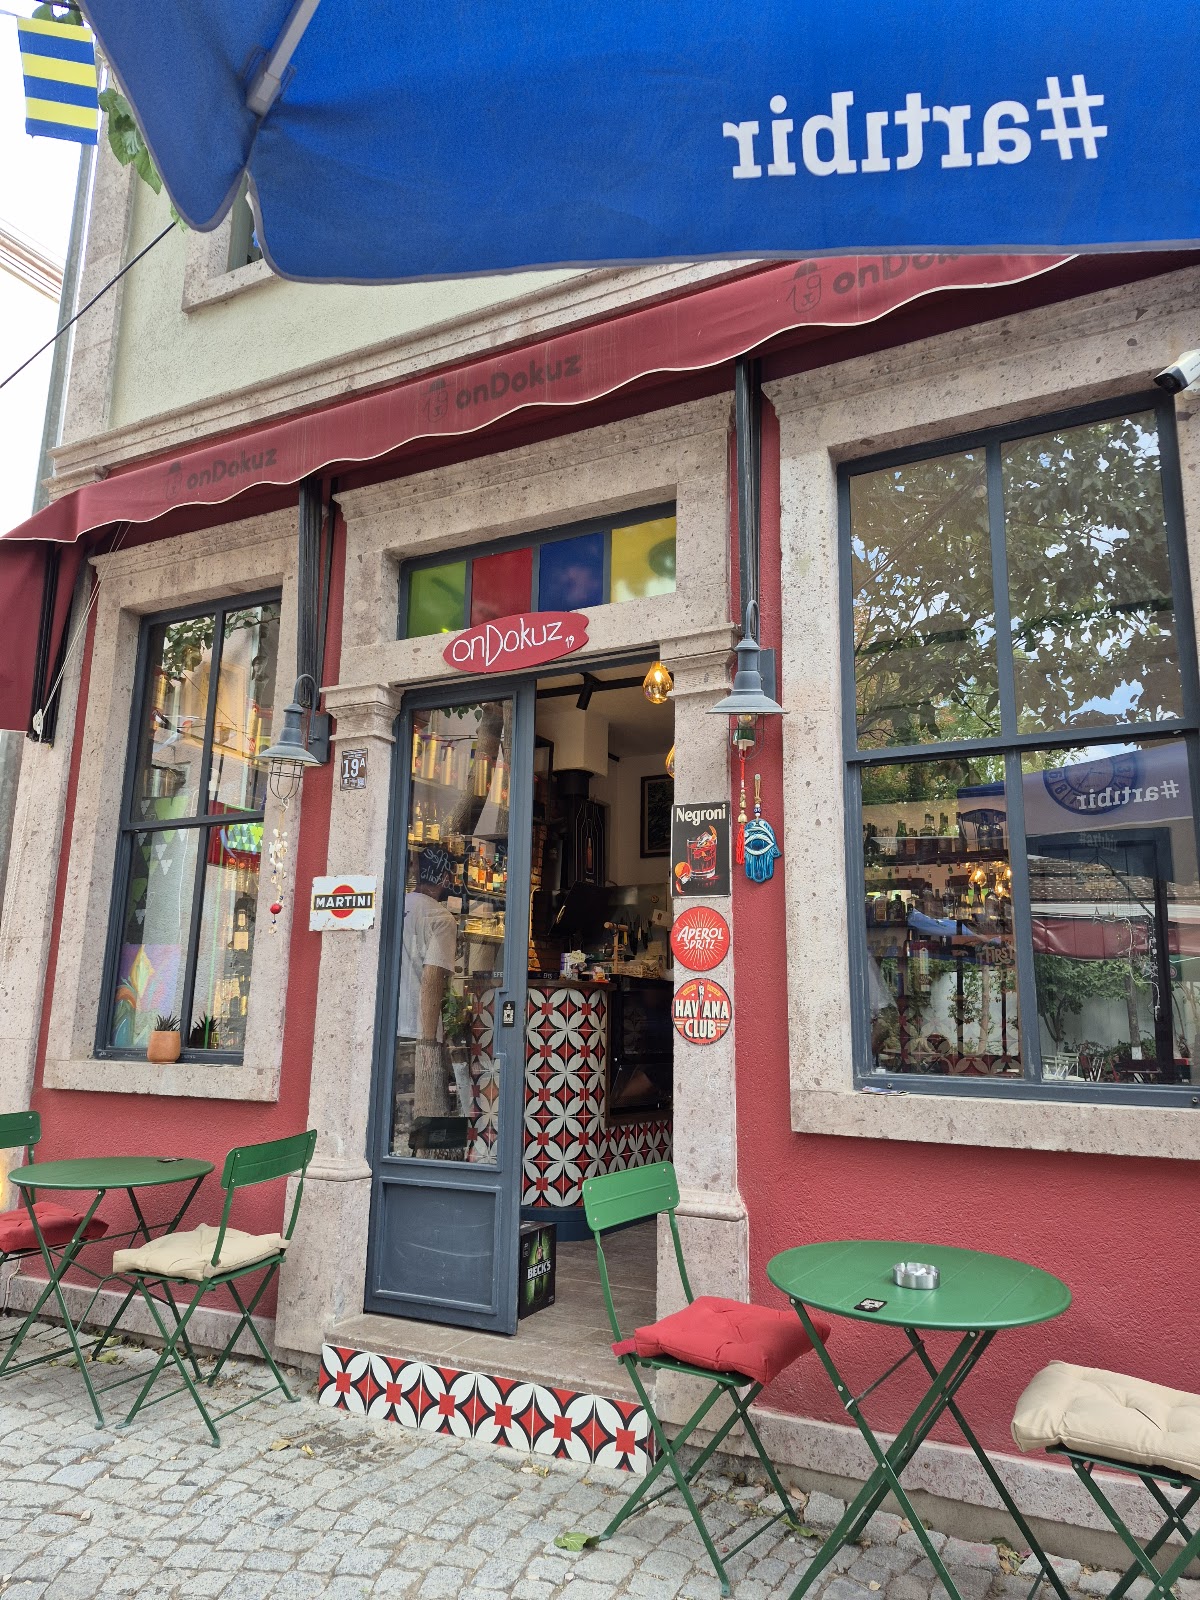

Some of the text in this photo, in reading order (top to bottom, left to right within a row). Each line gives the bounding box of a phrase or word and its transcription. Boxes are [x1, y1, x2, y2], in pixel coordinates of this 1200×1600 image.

[456, 354, 582, 410] onDokuz
[186, 448, 277, 490] onDokuz
[452, 617, 575, 667] onDokuz 19
[676, 803, 726, 825] Negroni
[316, 895, 371, 908] MARTINI
[677, 925, 724, 942] APEROL
[683, 939, 716, 950] SPRITZ
[674, 999, 730, 1019] HAVANA
[684, 1019, 717, 1039] CLUB
